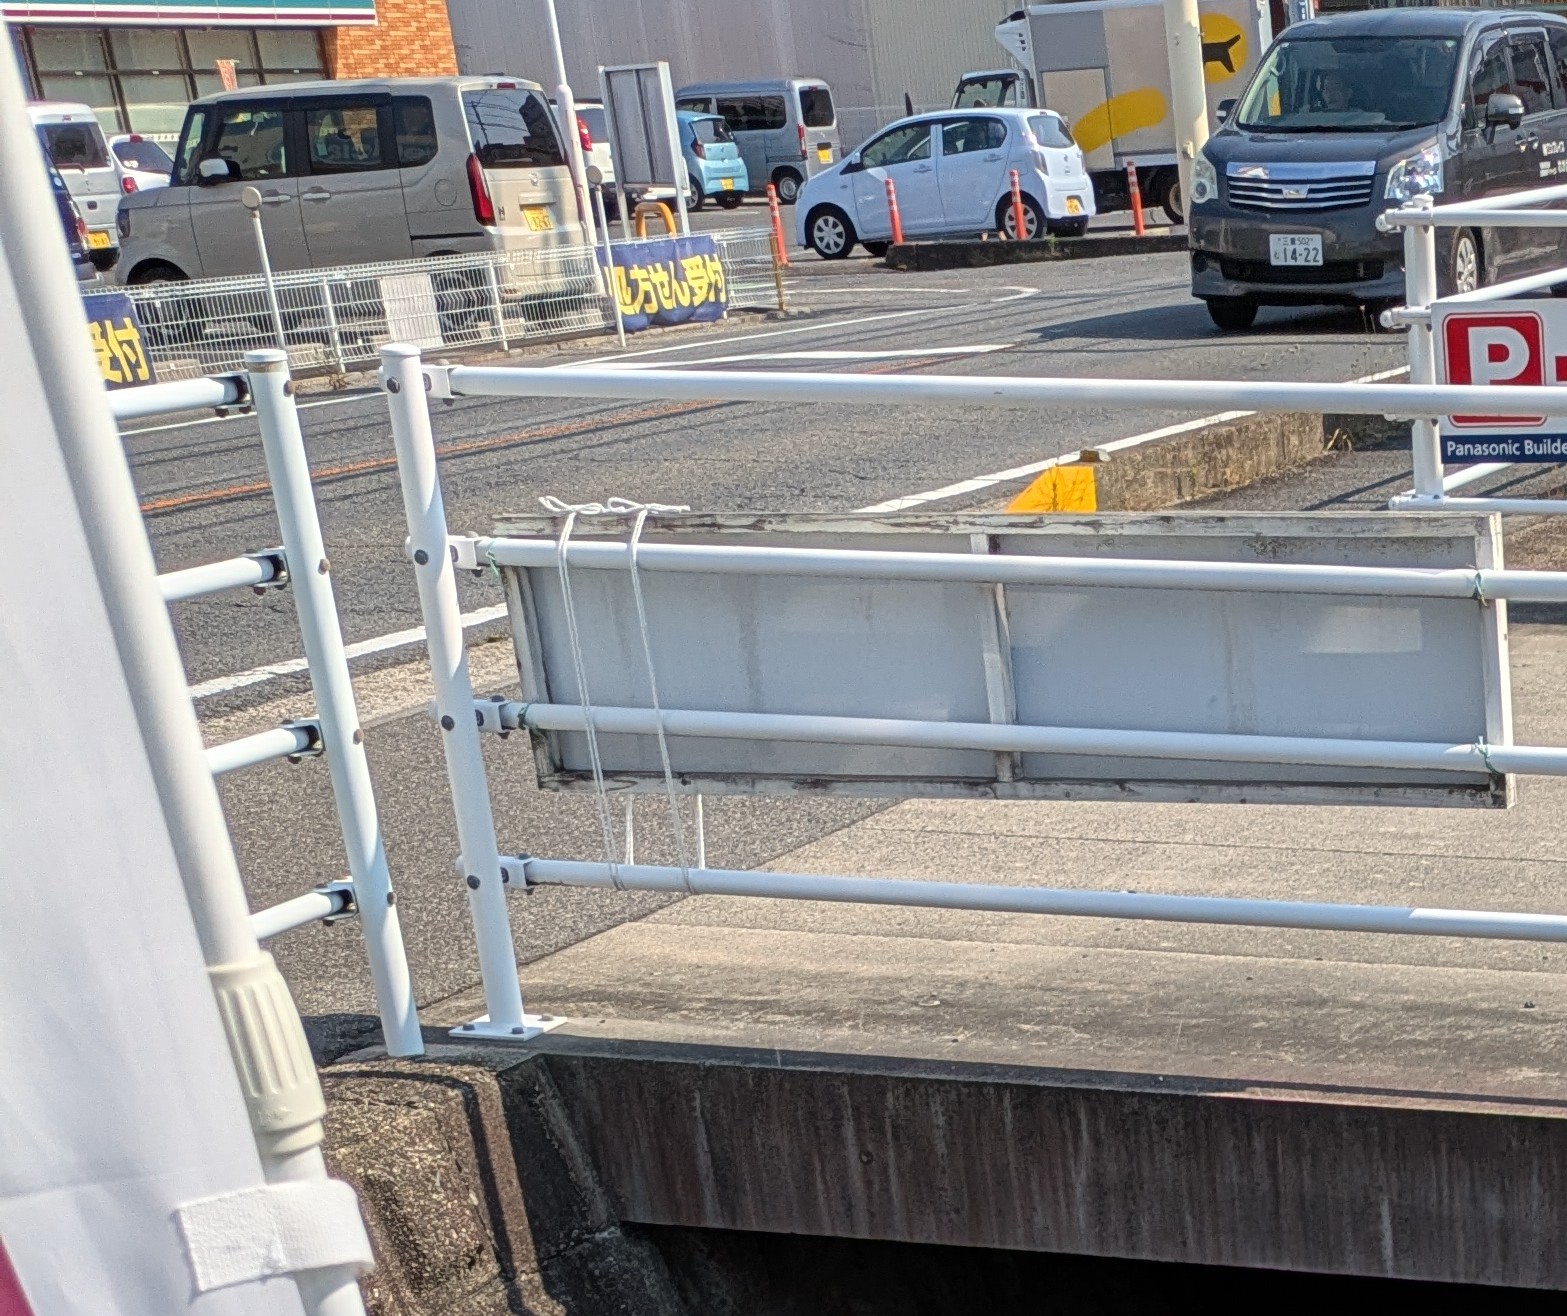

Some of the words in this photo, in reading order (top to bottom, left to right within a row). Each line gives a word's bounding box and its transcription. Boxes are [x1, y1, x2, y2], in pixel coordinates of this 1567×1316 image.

[1283, 247, 1320, 263] 14-22
[1468, 326, 1530, 386] P
[1447, 440, 1521, 457] Panasonic
